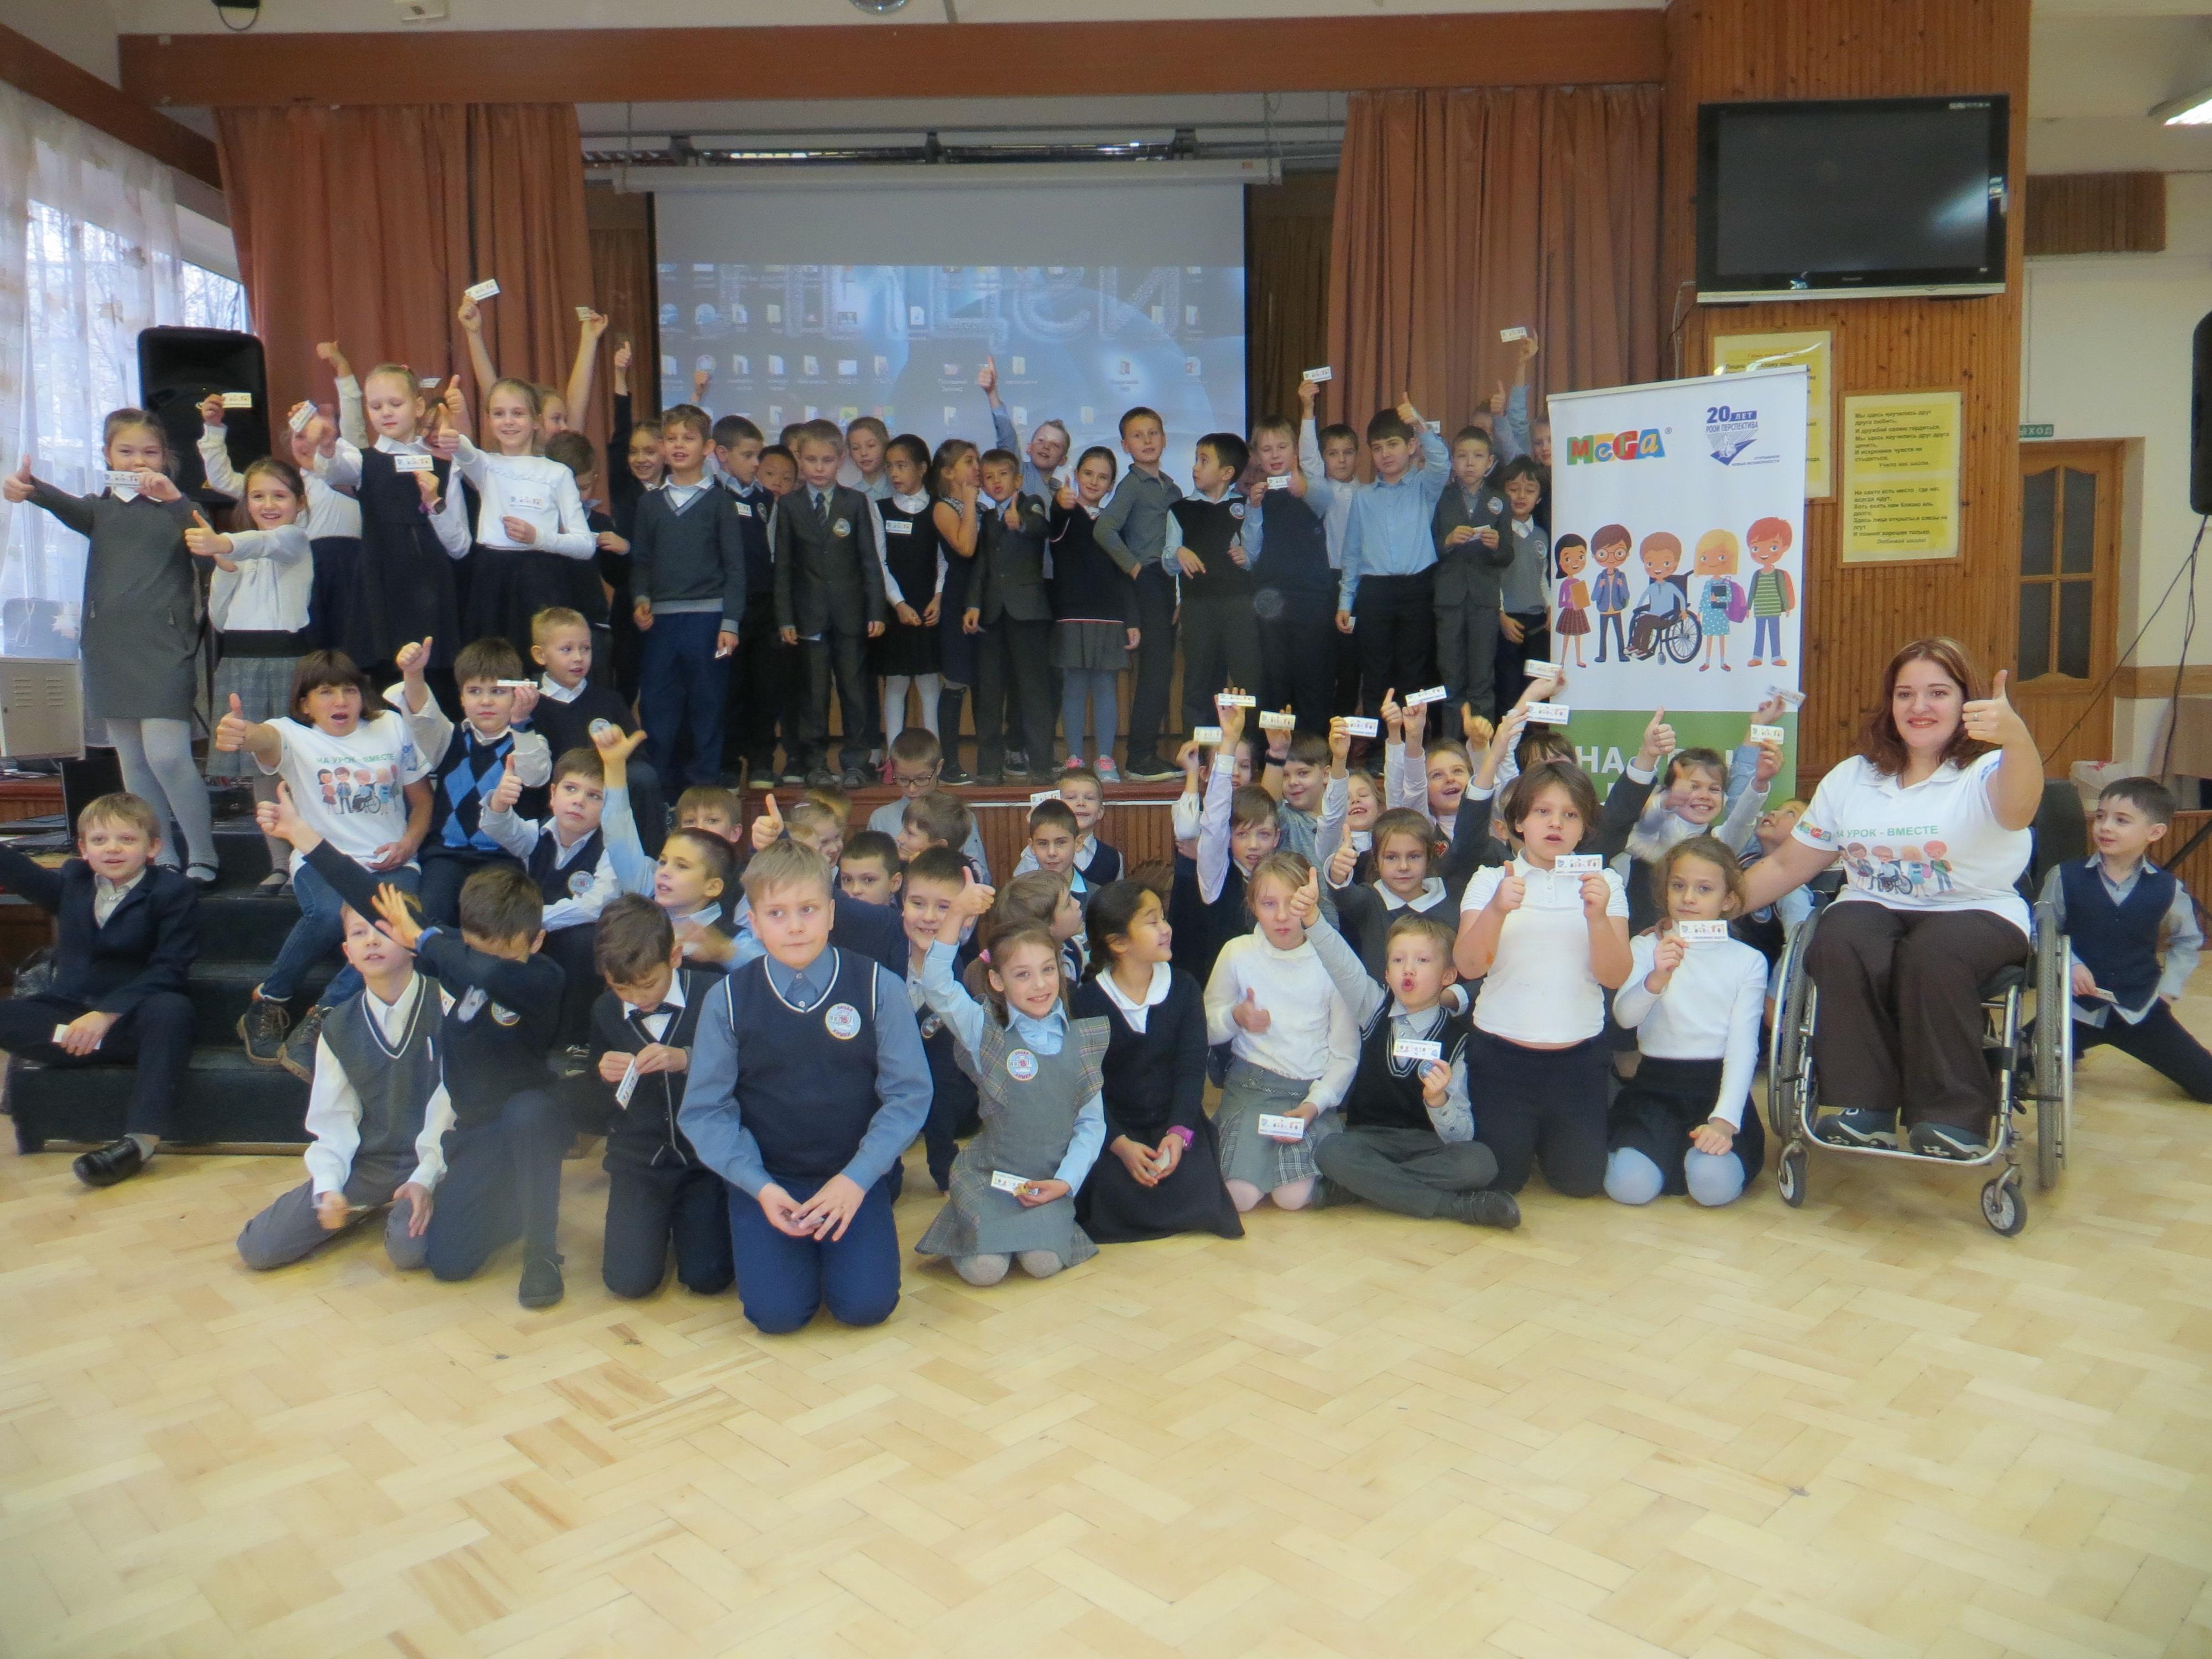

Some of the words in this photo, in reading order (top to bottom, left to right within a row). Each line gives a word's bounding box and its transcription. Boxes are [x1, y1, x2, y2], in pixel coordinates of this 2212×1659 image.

[1707, 405, 1730, 424] 20
[1721, 421, 1759, 431] ПЕРСПЕКТИВА
[362, 753, 395, 763] ВМЕСТЕ
[1574, 746, 1625, 774] НА
[1847, 828, 1877, 838] УРОК
[1887, 825, 1939, 837] ВМЕСТЕ
